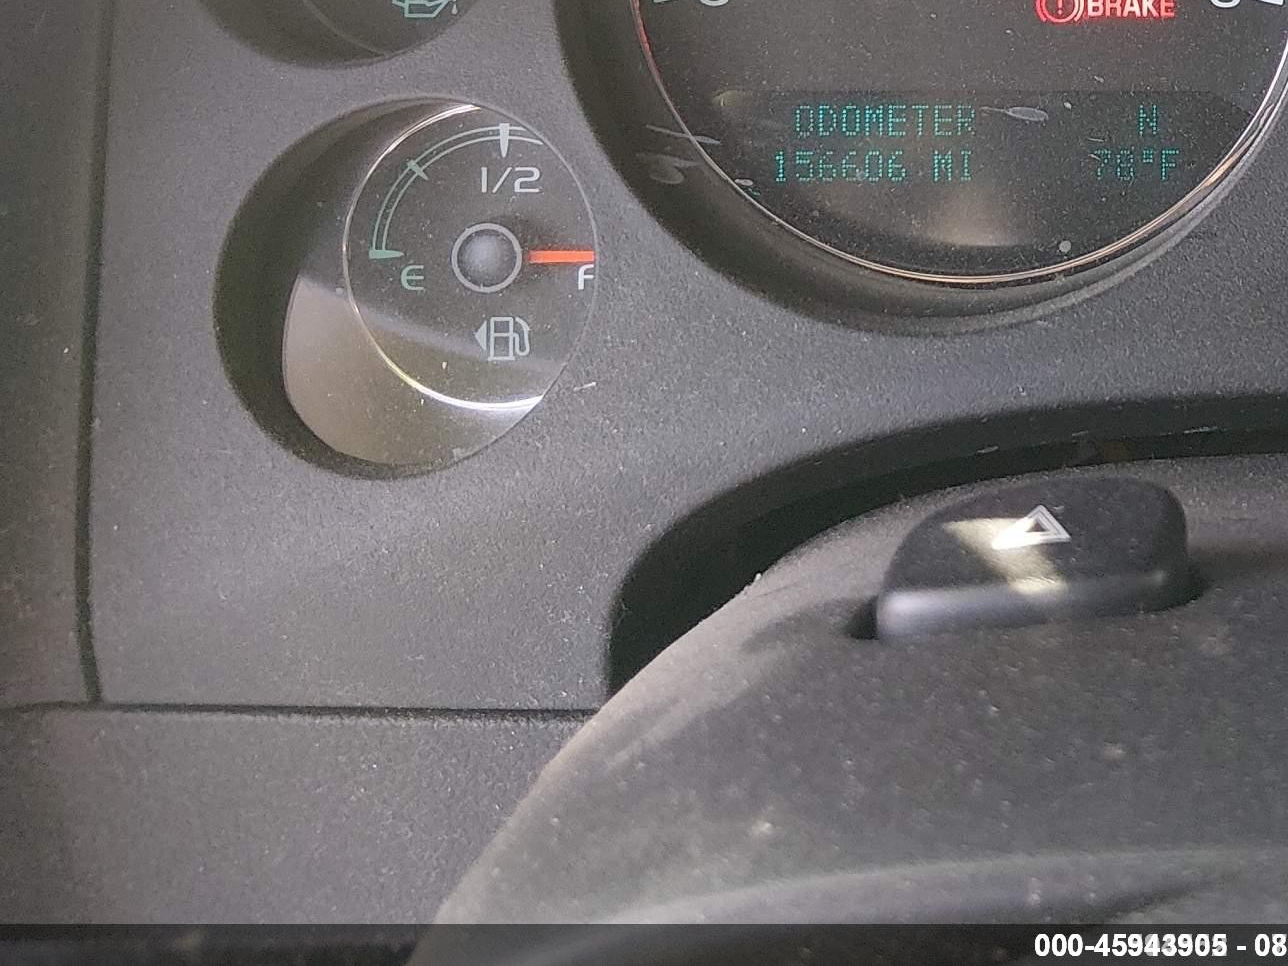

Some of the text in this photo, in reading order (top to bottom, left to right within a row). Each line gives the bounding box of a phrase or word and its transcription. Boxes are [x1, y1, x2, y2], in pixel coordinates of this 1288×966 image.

[794, 104, 976, 137] ODOMETER
[1138, 104, 1159, 135] N
[480, 166, 540, 195] 1/2
[774, 150, 972, 182] 156606 MI
[401, 265, 424, 291] E
